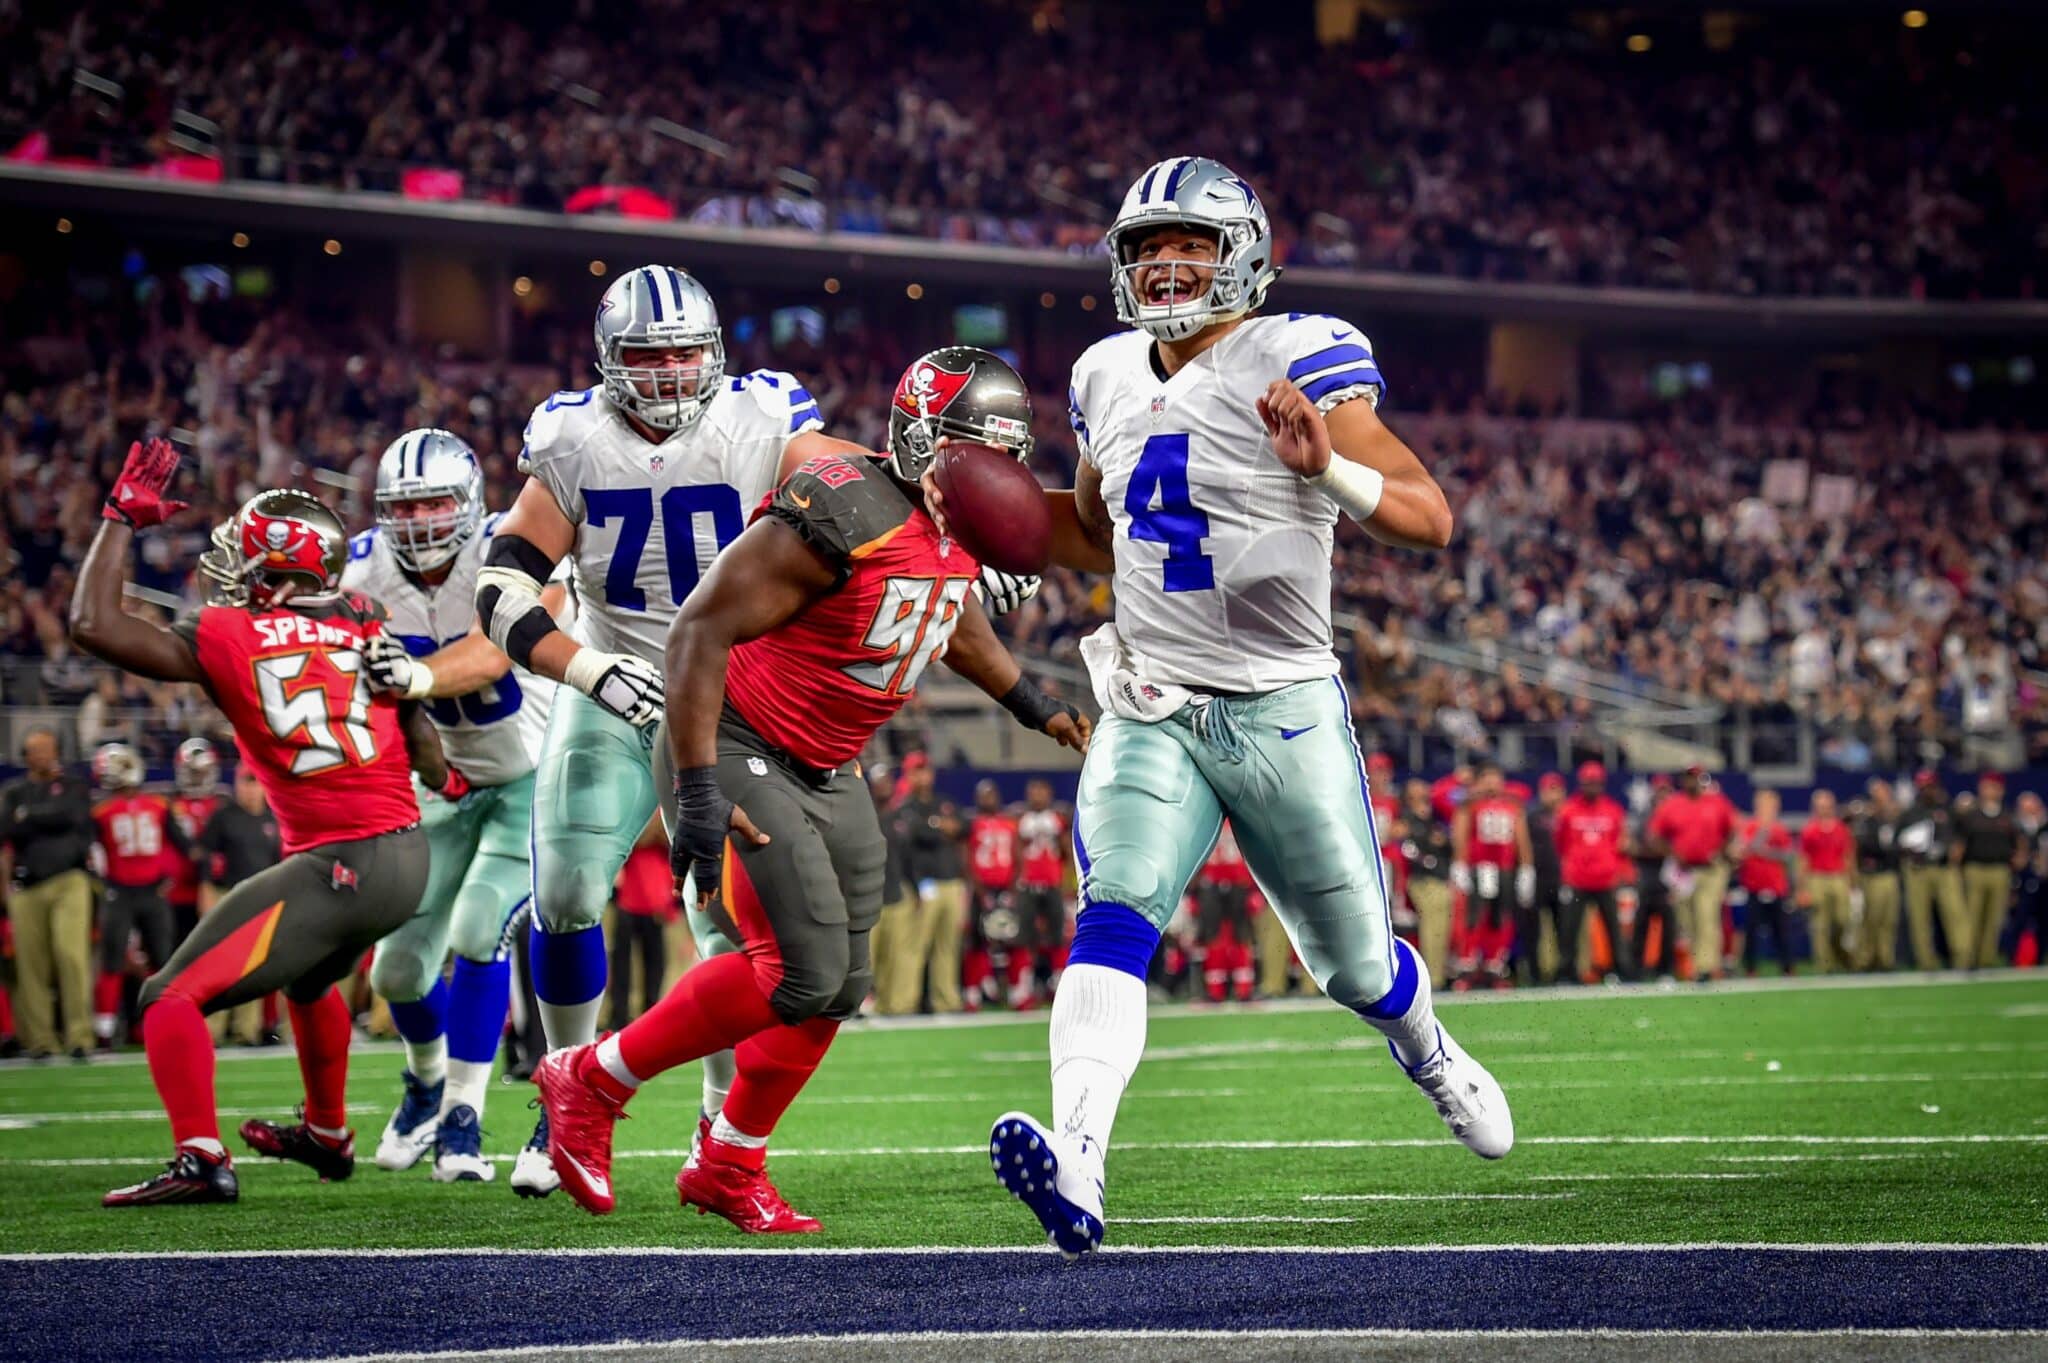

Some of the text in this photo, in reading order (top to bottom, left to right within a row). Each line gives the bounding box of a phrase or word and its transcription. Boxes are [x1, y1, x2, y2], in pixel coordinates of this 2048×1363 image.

[580, 484, 744, 612] 70
[1124, 433, 1215, 592] 4
[840, 573, 978, 697] 98
[250, 647, 381, 777] 57
